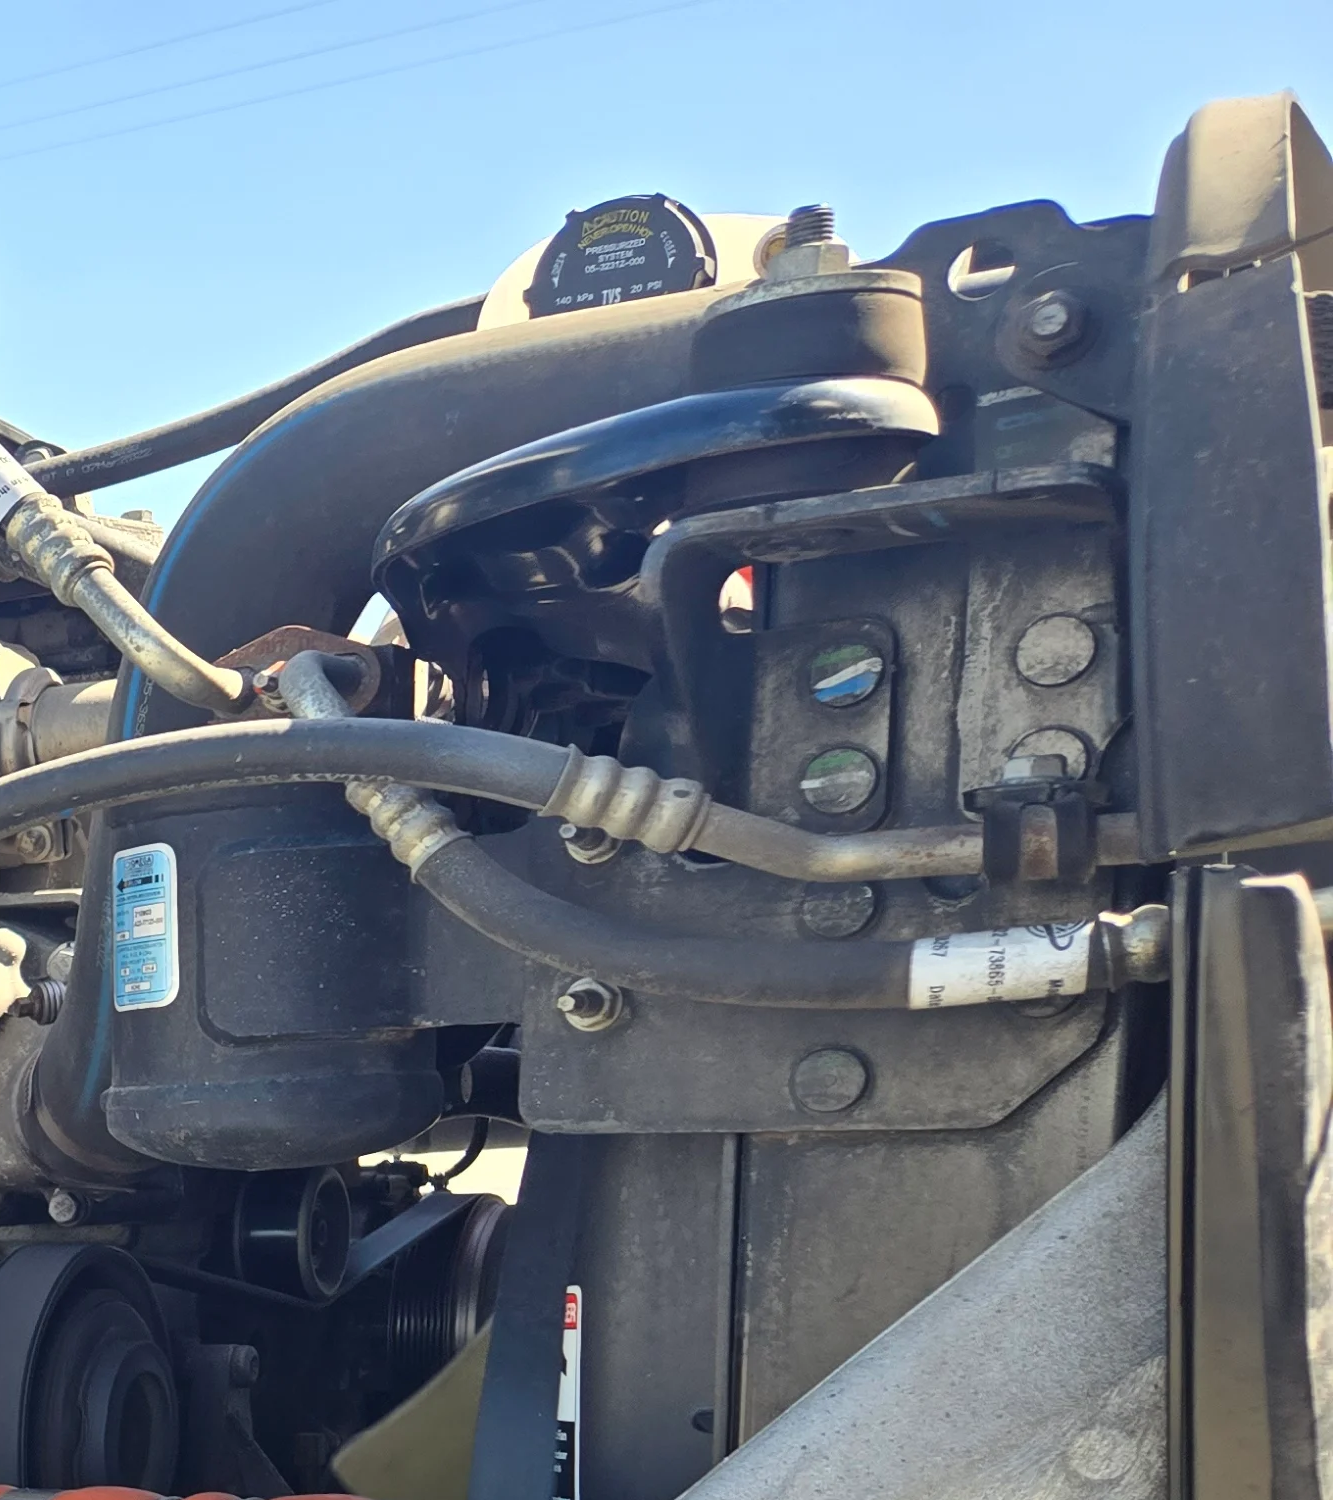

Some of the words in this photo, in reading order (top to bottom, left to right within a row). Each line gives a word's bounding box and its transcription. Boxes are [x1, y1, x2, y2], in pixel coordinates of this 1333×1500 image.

[630, 284, 643, 294] 20
[646, 280, 663, 291] PSI
[601, 287, 622, 305] TVS
